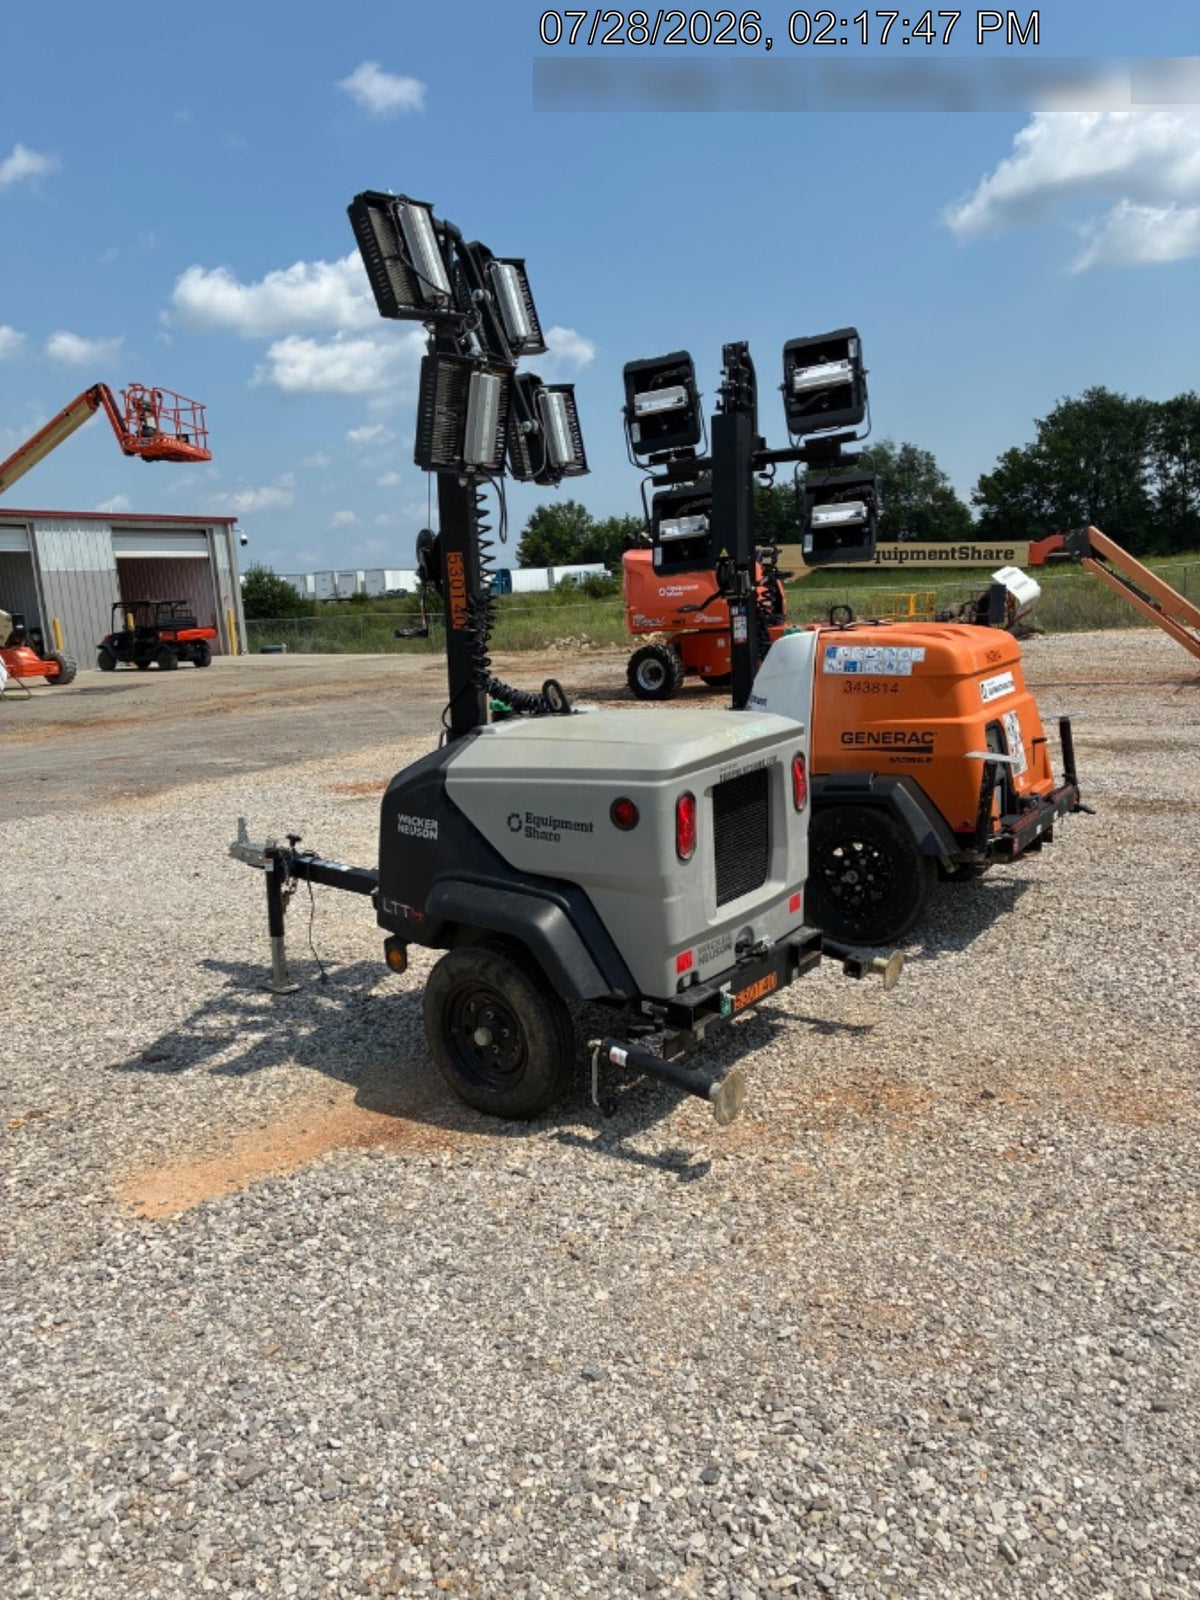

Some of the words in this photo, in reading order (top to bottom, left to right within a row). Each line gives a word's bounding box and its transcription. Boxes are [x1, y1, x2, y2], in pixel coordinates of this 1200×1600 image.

[872, 546, 1015, 564] quipmentShare
[843, 680, 899, 694] 343814
[841, 731, 934, 744] GENERAC
[397, 813, 439, 829] WACKER
[524, 812, 594, 833] Equipment
[397, 823, 439, 841] NEUSON
[524, 827, 561, 842] Share
[382, 897, 425, 921] LTT4
